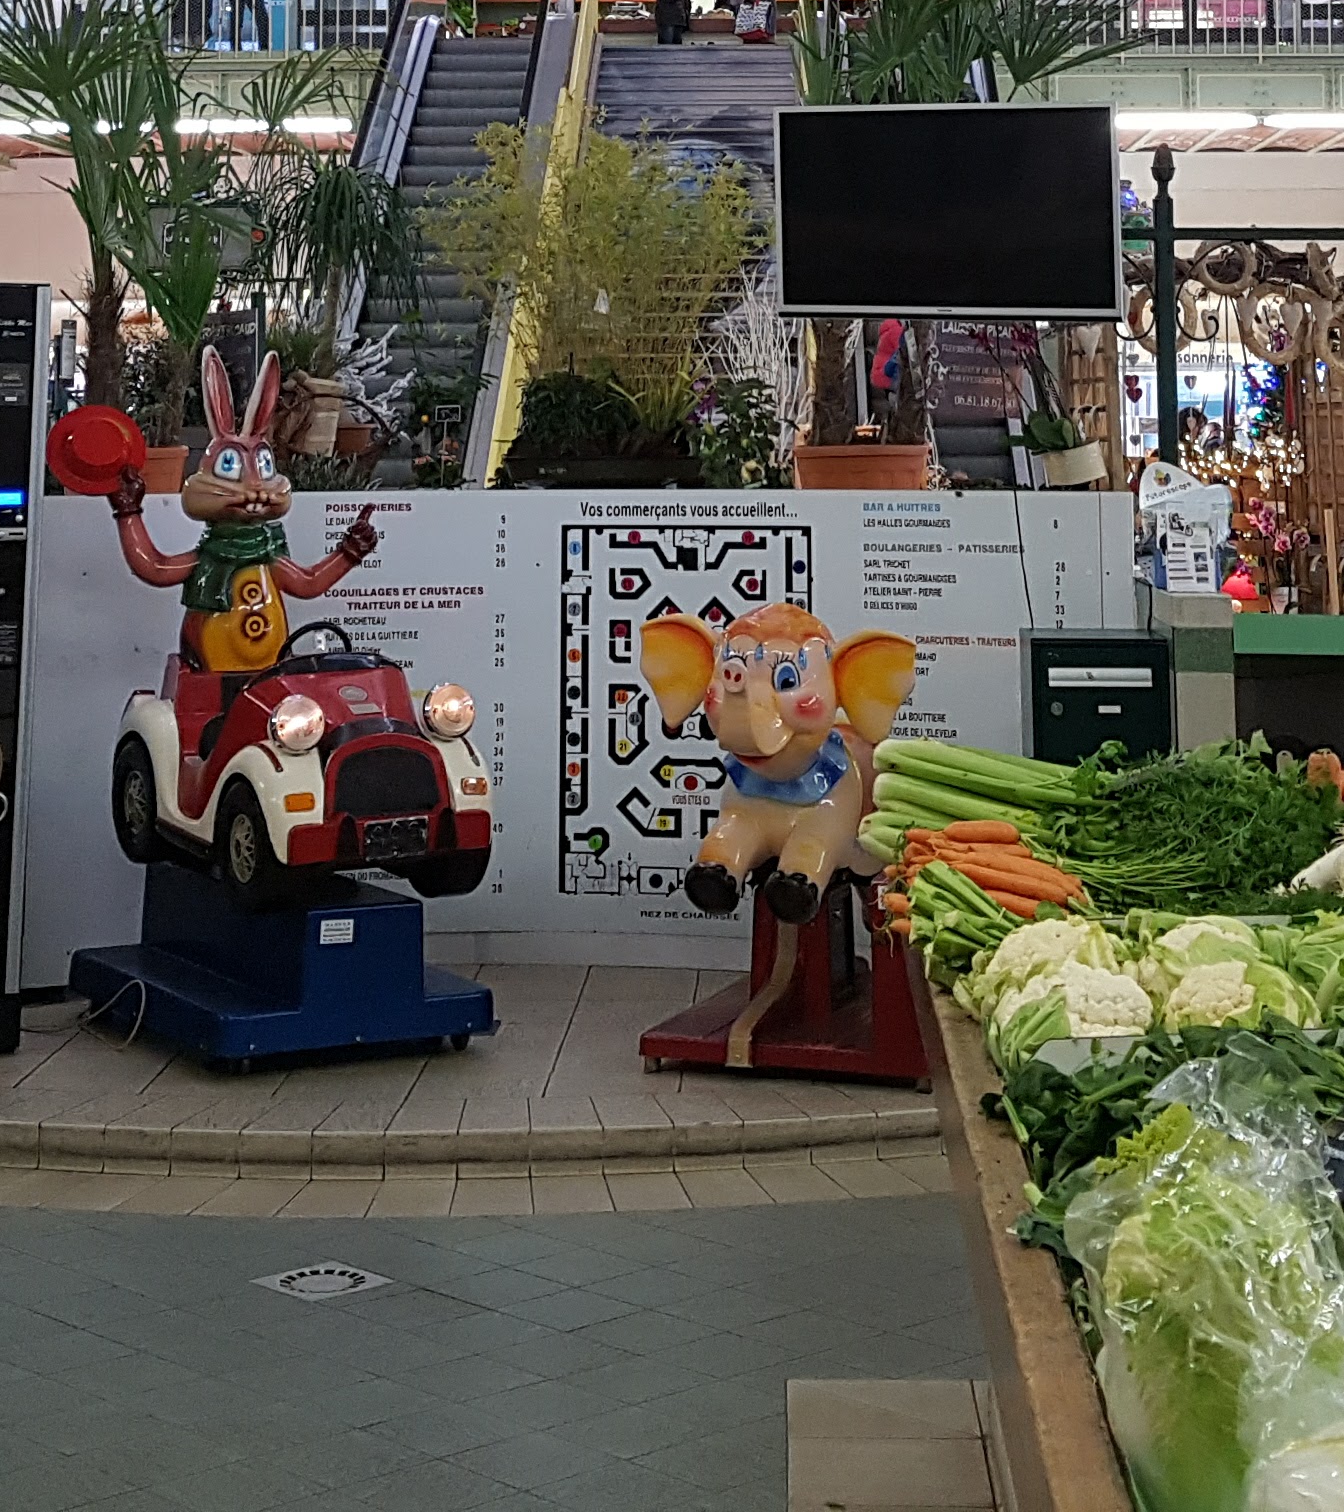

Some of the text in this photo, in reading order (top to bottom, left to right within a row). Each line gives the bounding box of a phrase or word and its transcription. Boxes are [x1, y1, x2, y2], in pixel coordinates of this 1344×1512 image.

[325, 503, 412, 513] POISSONERIES
[580, 502, 798, 521] Vos commerçants vous accueillent...
[863, 503, 941, 512] BAR A HUITRES
[325, 517, 334, 526] LE
[863, 518, 875, 528] LES
[877, 518, 902, 528] HALLES
[904, 519, 951, 528] GOURMANDES
[497, 529, 506, 539] 10
[863, 543, 942, 553] BOULANGERIES
[958, 544, 1025, 554] PATISSERIES
[863, 559, 881, 568] SARL
[863, 573, 896, 583] TARTINES
[1055, 576, 1061, 586] 2
[324, 586, 484, 598] COQUILLAGES ET CRUSTACES
[863, 587, 892, 597] ATELIER
[918, 588, 942, 597] PIERRE
[1055, 591, 1060, 601] 7
[347, 600, 461, 611] TRAITEUR DE LA MER
[1055, 605, 1065, 615] 33
[343, 617, 387, 626] ROCHETEAU
[495, 614, 505, 624] 27
[1055, 620, 1063, 629] 12
[355, 632, 365, 641] DE
[366, 632, 376, 640] LA
[915, 637, 969, 646] CHARCUTERIES
[977, 638, 1016, 647] TRAITEURS
[495, 643, 505, 653] 24
[494, 657, 505, 667] 25
[493, 703, 504, 713] 30
[898, 713, 946, 723] LA BOUTTIERE
[495, 732, 504, 742] 21
[493, 747, 504, 757] 34
[493, 762, 504, 772] 32
[492, 776, 503, 786] 37
[672, 794, 687, 806] VOUS
[688, 794, 701, 806] ETES
[492, 823, 503, 833] 40
[498, 869, 503, 878] 1
[640, 910, 661, 919] REZ
[664, 910, 679, 919] DE
